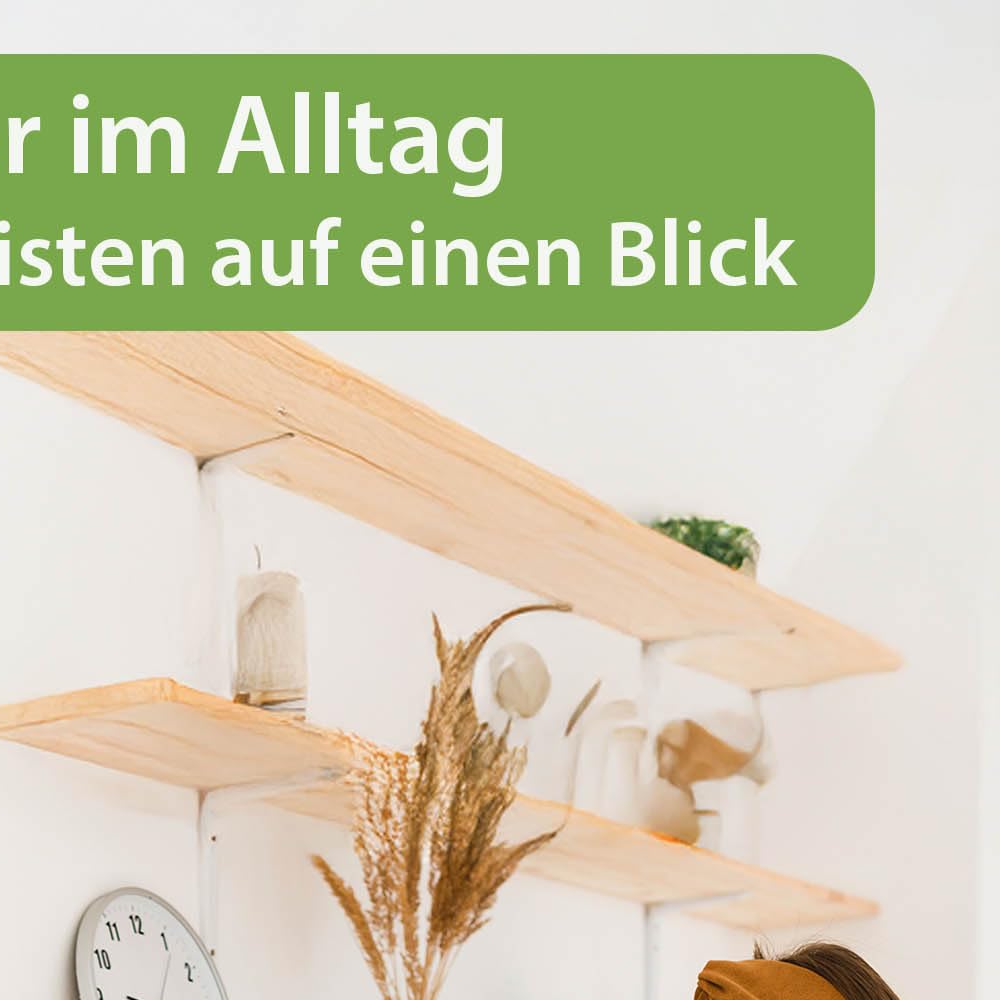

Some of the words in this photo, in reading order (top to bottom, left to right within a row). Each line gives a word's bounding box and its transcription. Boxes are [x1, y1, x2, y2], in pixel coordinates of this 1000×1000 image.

[106, 921, 120, 941] 11
[129, 915, 144, 935] 12
[161, 932, 168, 950] 1
[94, 949, 111, 970] 10
[184, 962, 194, 982] 2
